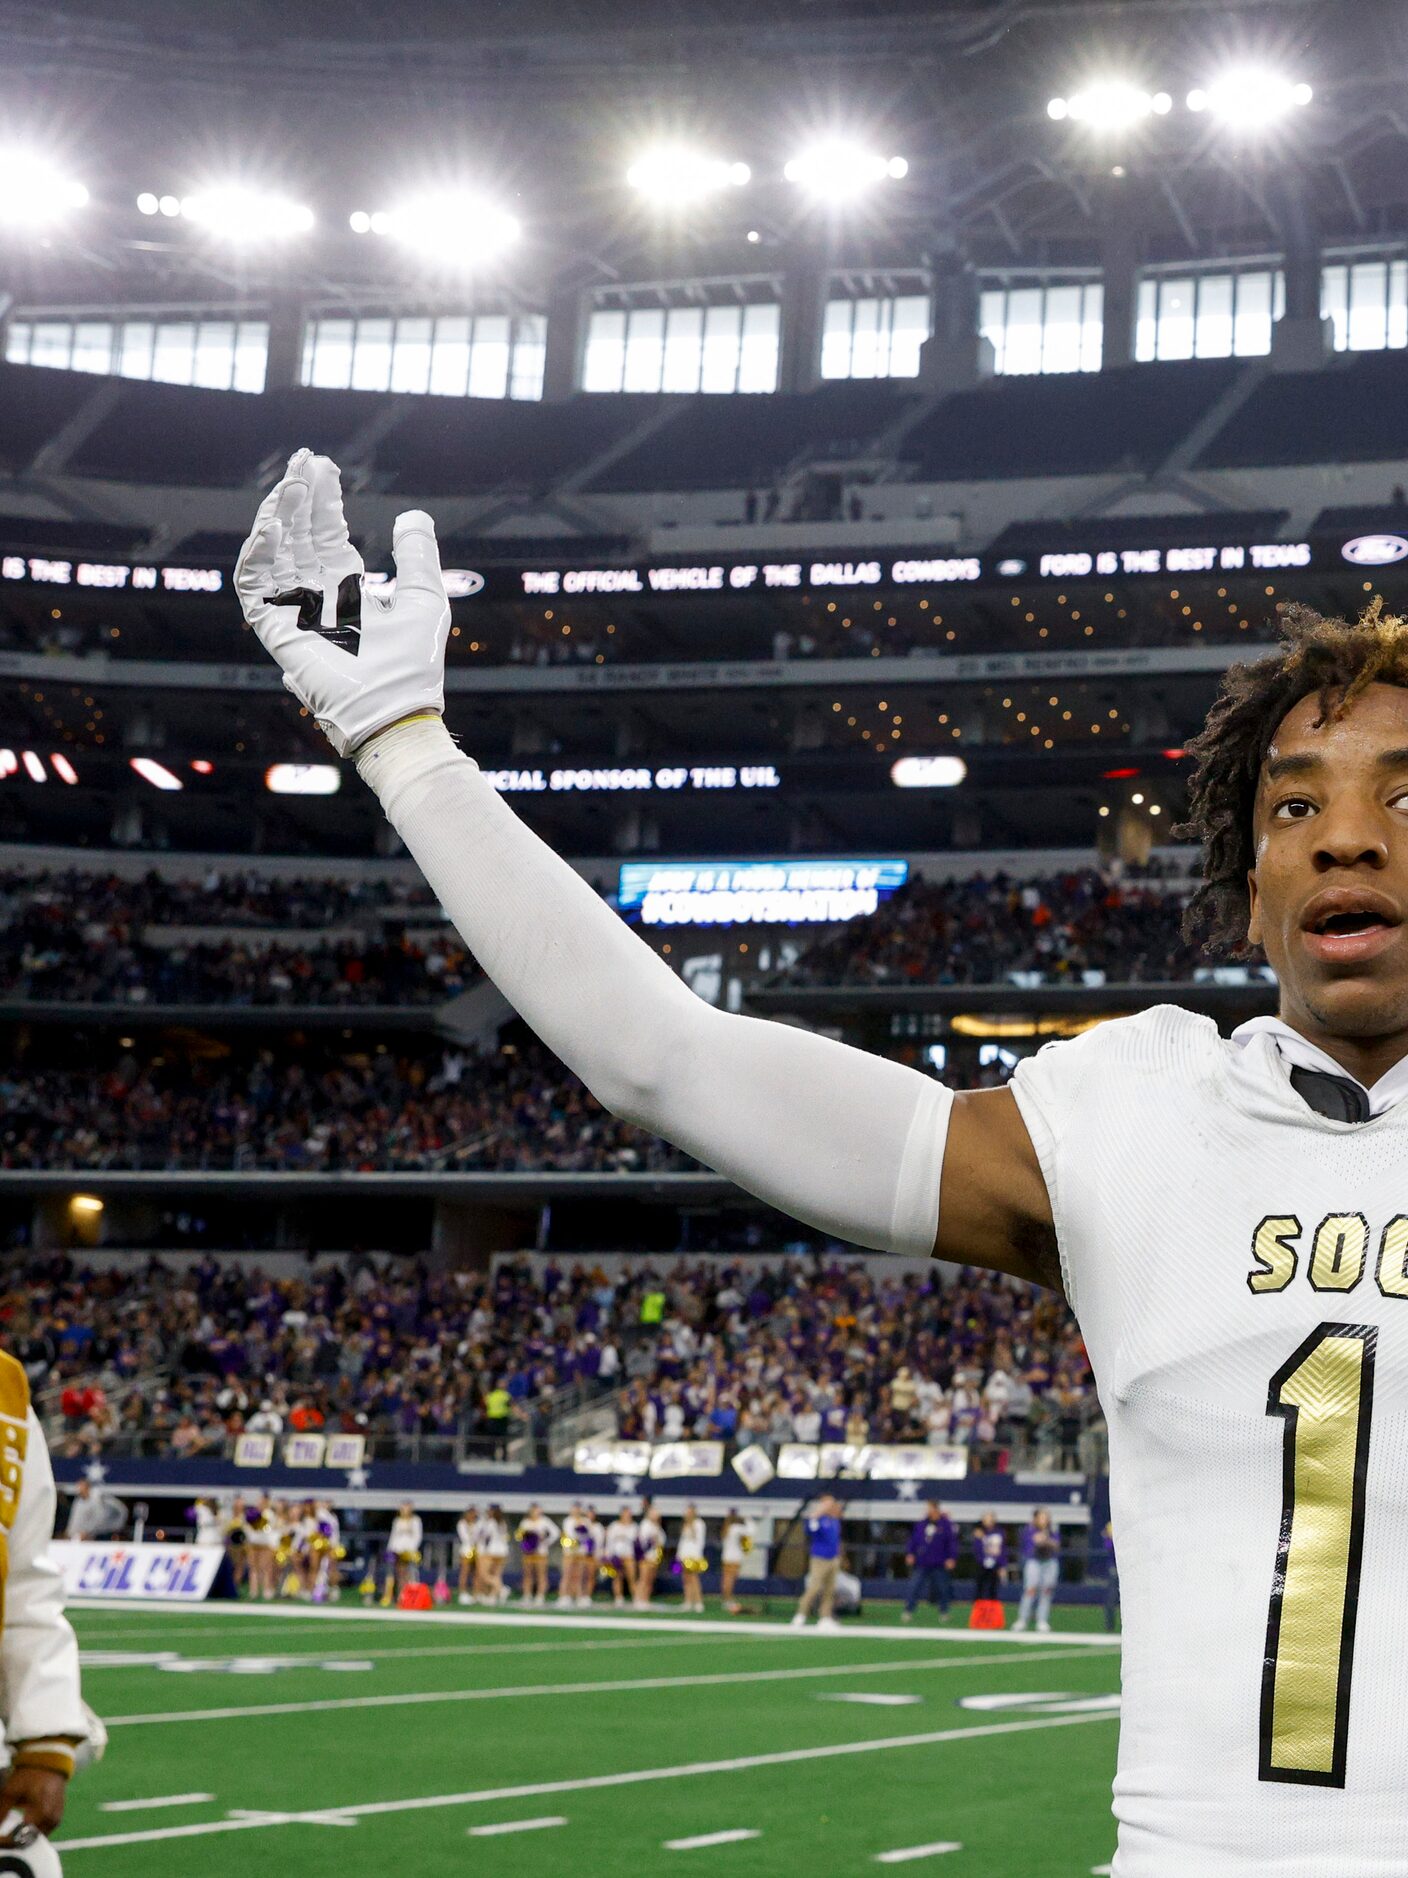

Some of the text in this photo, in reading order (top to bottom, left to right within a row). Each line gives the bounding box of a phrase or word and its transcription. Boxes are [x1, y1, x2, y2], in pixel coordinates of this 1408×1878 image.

[2, 556, 222, 591] IS THE BEST IN TEXAS
[521, 571, 560, 593] THE
[563, 570, 643, 592] OFFICIAL
[648, 566, 725, 590] VEHICLE
[729, 565, 758, 588] OF
[762, 564, 802, 587] THE
[810, 561, 882, 586] DALLAS
[892, 558, 981, 583] COWBOYS
[1040, 553, 1092, 577] FORD
[1096, 551, 1118, 574] IS
[1120, 550, 1161, 573] THE
[1166, 547, 1218, 571] BEST
[1220, 546, 1245, 569] IN
[1249, 543, 1311, 568] TEXAS
[550, 767, 652, 790] SPONSOR
[655, 768, 688, 790] OF
[690, 767, 736, 788] THE
[739, 766, 780, 788] UIL
[1258, 1322, 1379, 1789] 1
